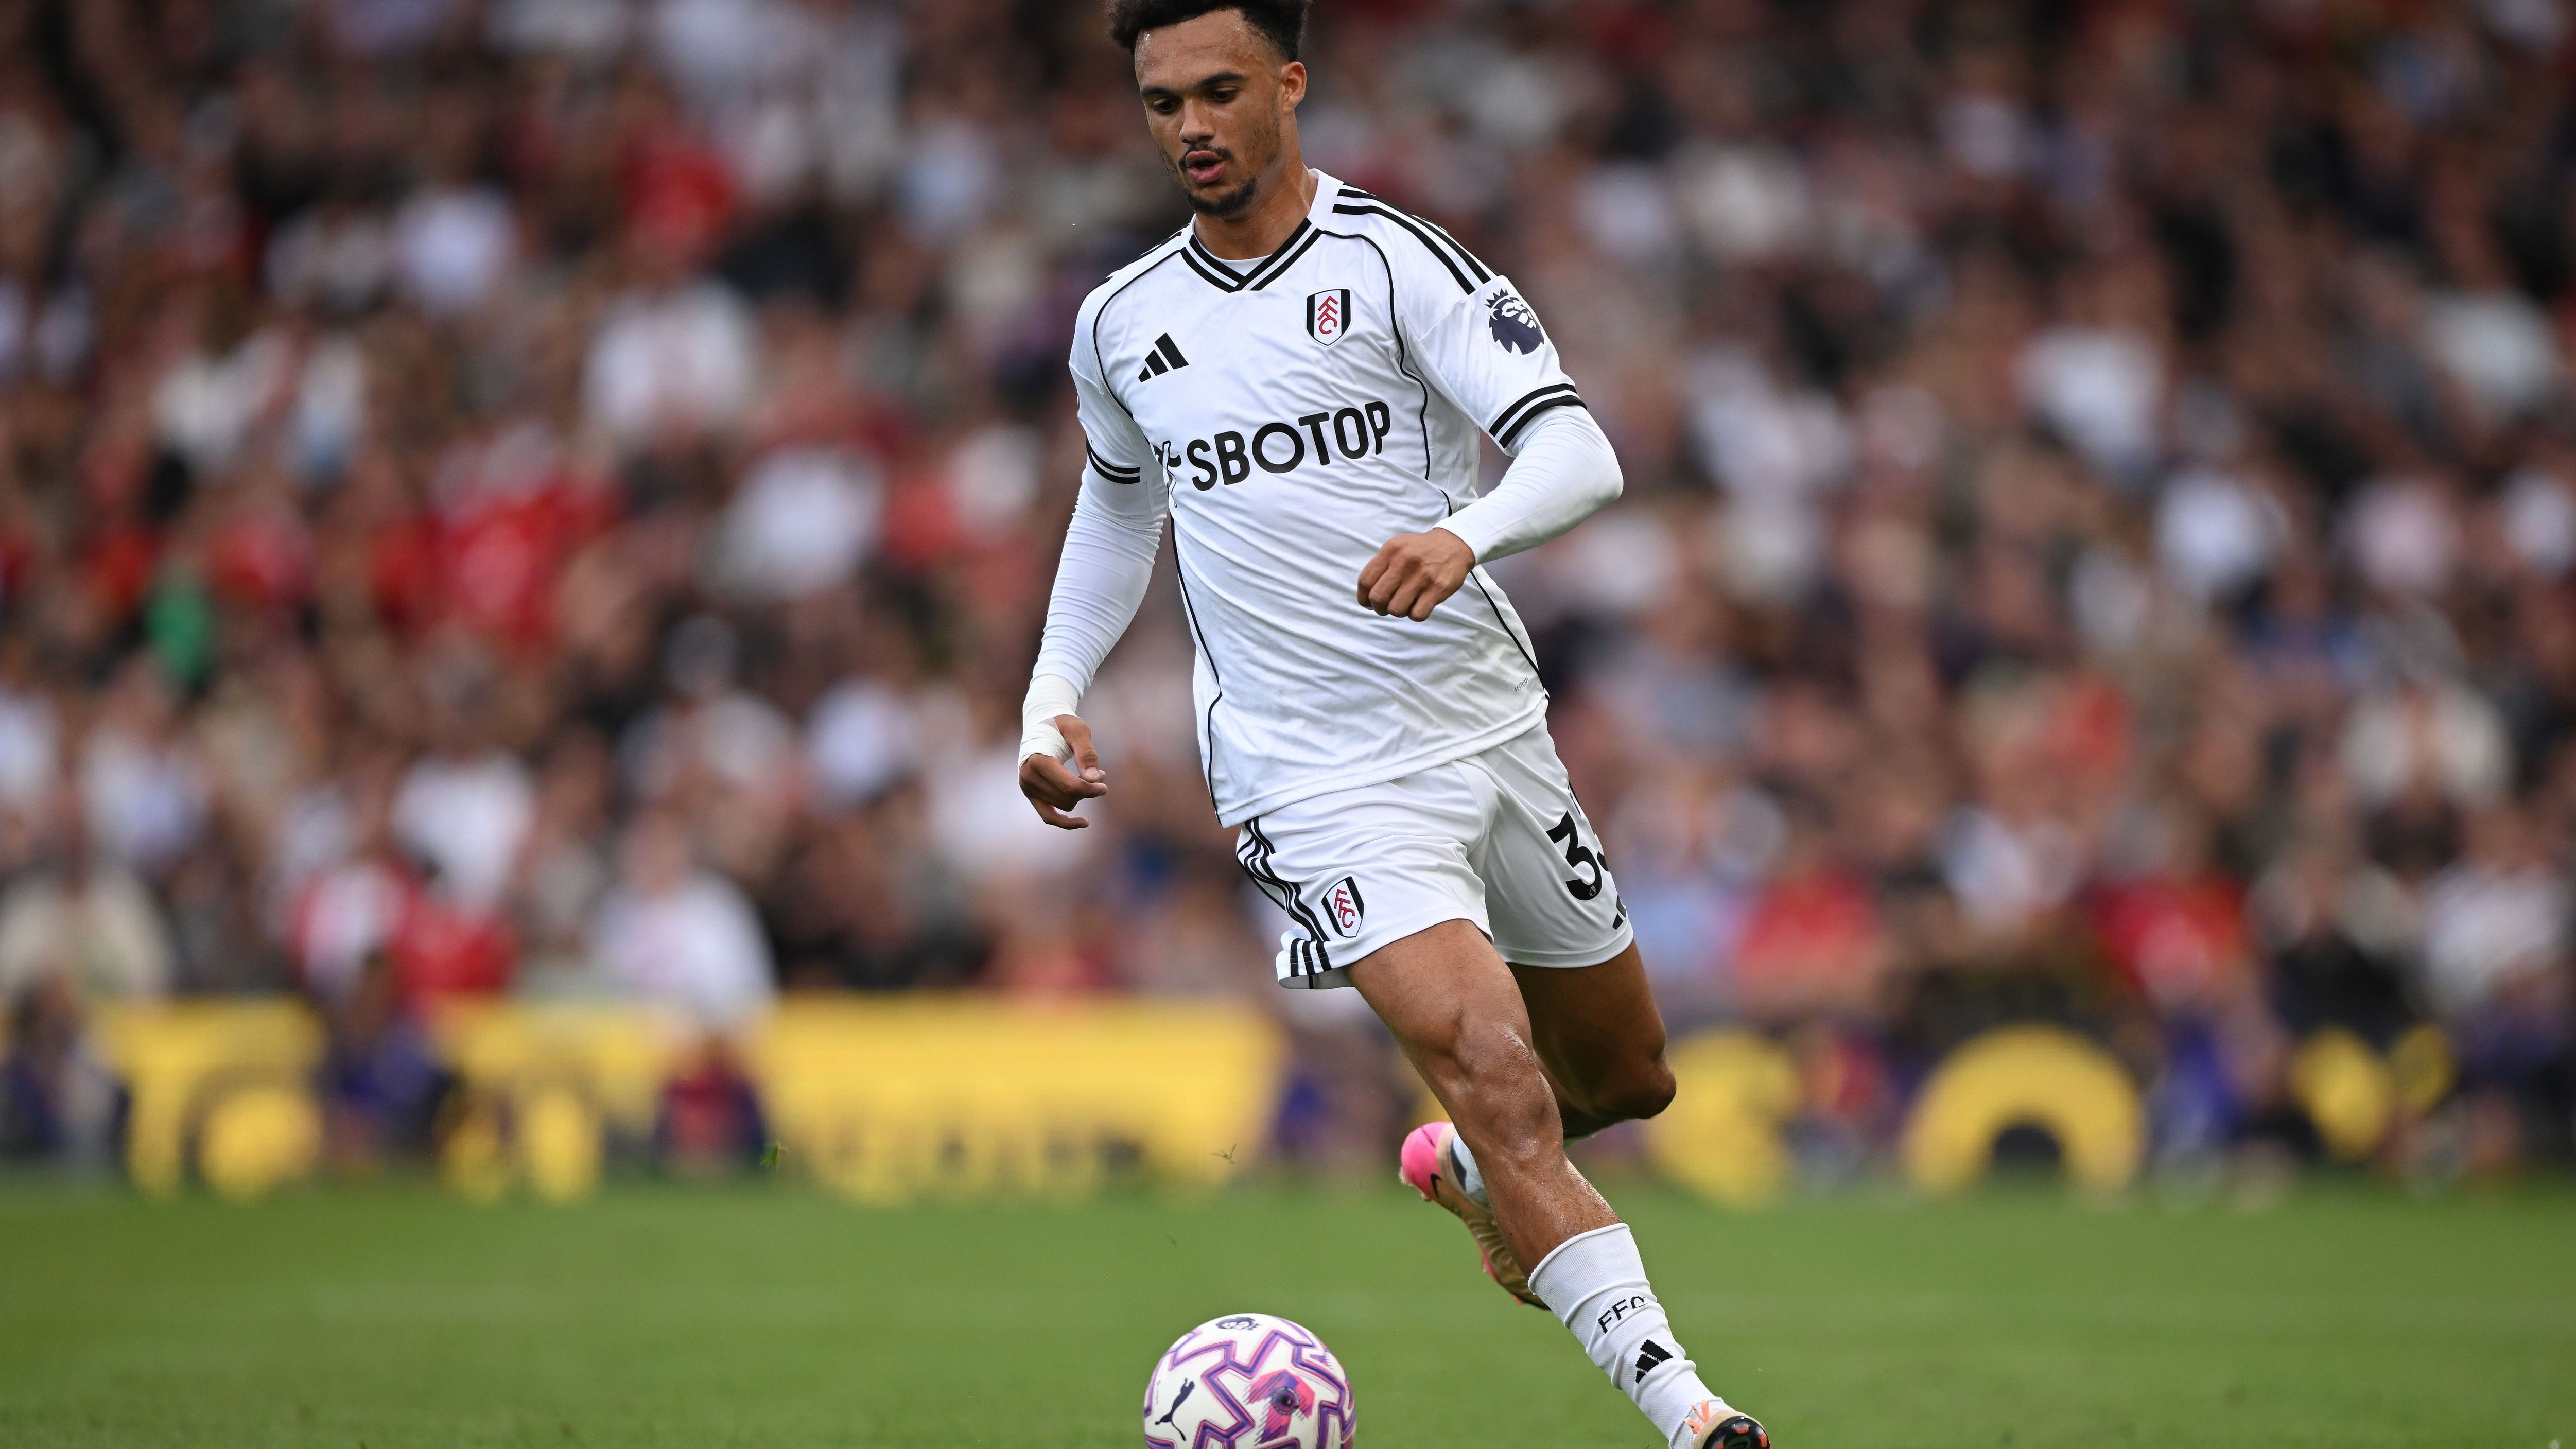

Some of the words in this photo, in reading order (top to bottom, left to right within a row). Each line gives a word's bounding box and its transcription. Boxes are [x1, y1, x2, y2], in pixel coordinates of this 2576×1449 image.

[1317, 295, 1338, 335] FFC
[1187, 401, 1390, 491] SBOTOP
[1546, 810, 1609, 901] 3
[1334, 889, 1355, 928] FFC
